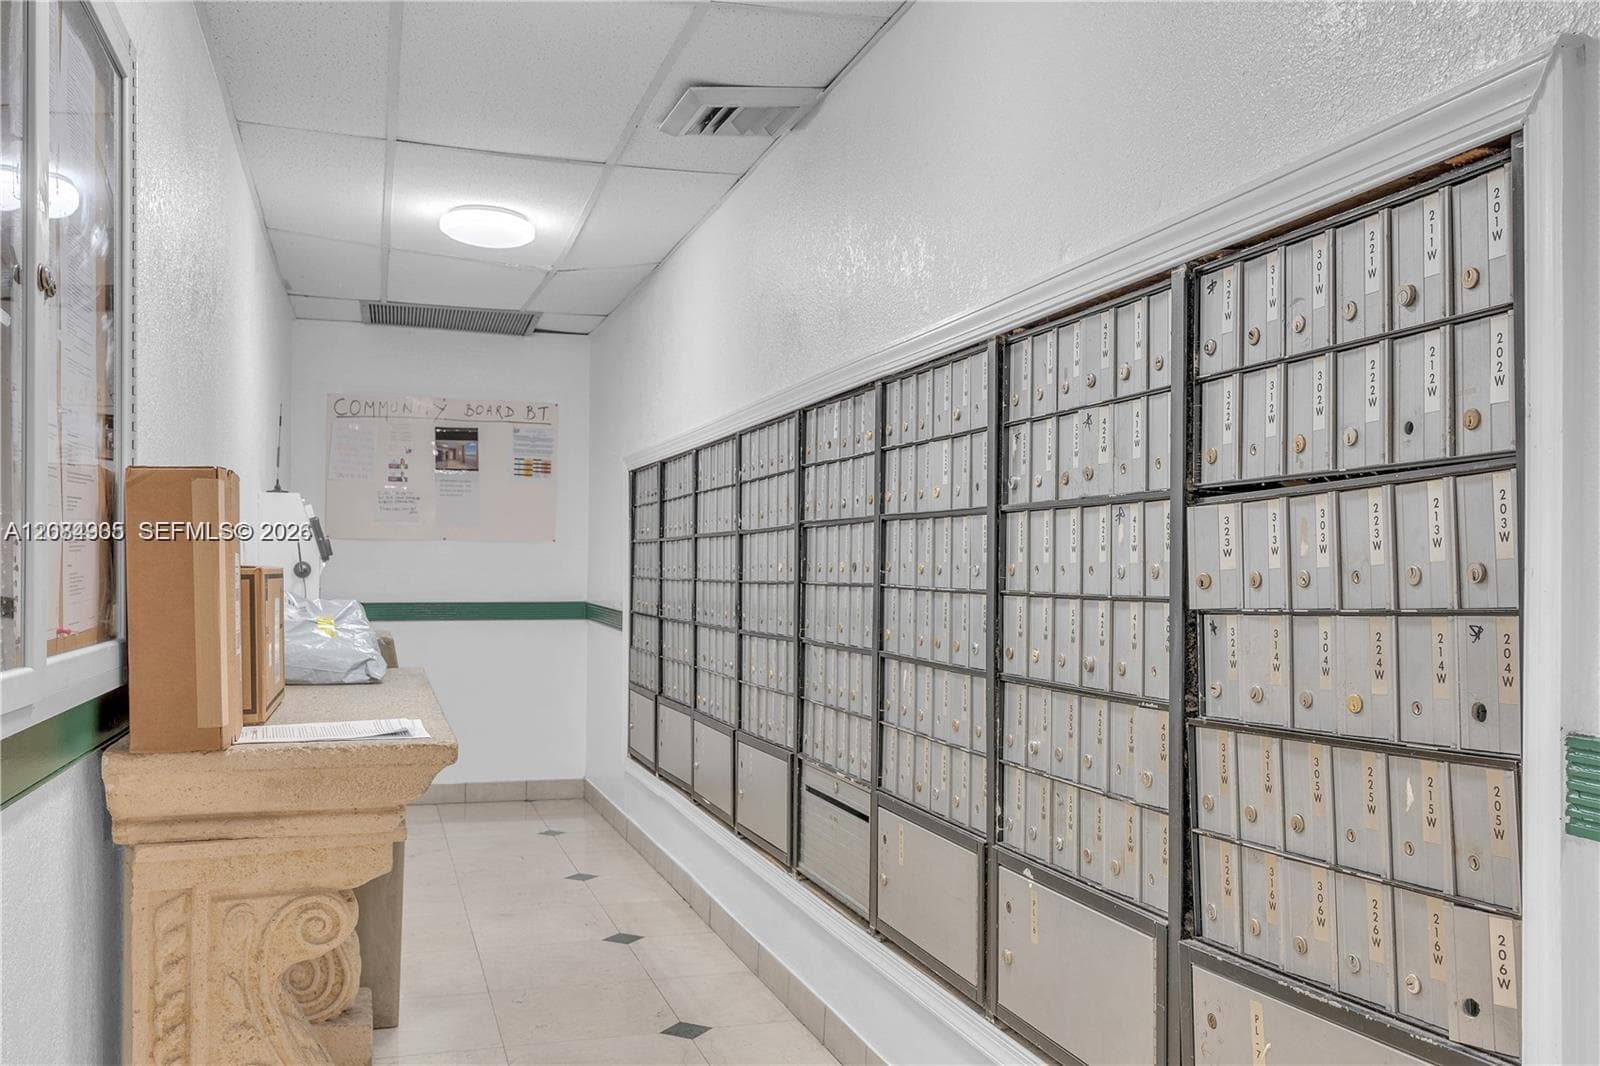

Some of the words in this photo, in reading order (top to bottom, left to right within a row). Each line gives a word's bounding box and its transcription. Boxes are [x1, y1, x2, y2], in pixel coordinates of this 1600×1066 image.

[1426, 209, 1438, 262] 211W
[1491, 187, 1504, 242] 201W
[1315, 249, 1324, 295] 301W
[1367, 230, 1378, 280] 221W
[1223, 278, 1233, 321] 321W
[1269, 264, 1278, 308] 311W
[1426, 345, 1438, 398] 212W
[1493, 331, 1506, 387] 202W
[1267, 380, 1277, 425] 312W
[1315, 370, 1325, 417] 302W
[1368, 359, 1378, 408] 222W
[333, 397, 447, 421] COMMUNY
[464, 403, 515, 420] BOARD
[526, 405, 549, 421] BT
[1133, 411, 1141, 448] 412W
[1224, 390, 1232, 432] 322W
[1100, 417, 1108, 453] 422W
[1222, 515, 1233, 559] 323W
[1270, 512, 1280, 556] 313W
[1318, 508, 1328, 555] 303W
[1372, 502, 1383, 551] 223W
[1432, 497, 1443, 549] 213W
[1498, 488, 1511, 544] 203W
[1229, 626, 1238, 669] 324W
[1271, 628, 1282, 673] 314W
[1321, 630, 1331, 678] 304W
[1373, 631, 1386, 681] 224W
[1435, 632, 1447, 685] 214W
[1501, 633, 1515, 688] 204W
[1159, 723, 1168, 761] 405W
[1220, 742, 1229, 785] 325W
[1264, 749, 1273, 794] 315W
[1312, 756, 1323, 803] 305W
[1366, 766, 1377, 816] 225W
[1426, 776, 1438, 829] 215W
[1492, 786, 1506, 841] 205W
[1223, 854, 1233, 897] 326W
[1268, 866, 1278, 912] 316W
[1316, 880, 1327, 929] 306W
[1371, 898, 1383, 949] 226W
[1432, 913, 1445, 967] 216W
[1496, 934, 1512, 992] 206W
